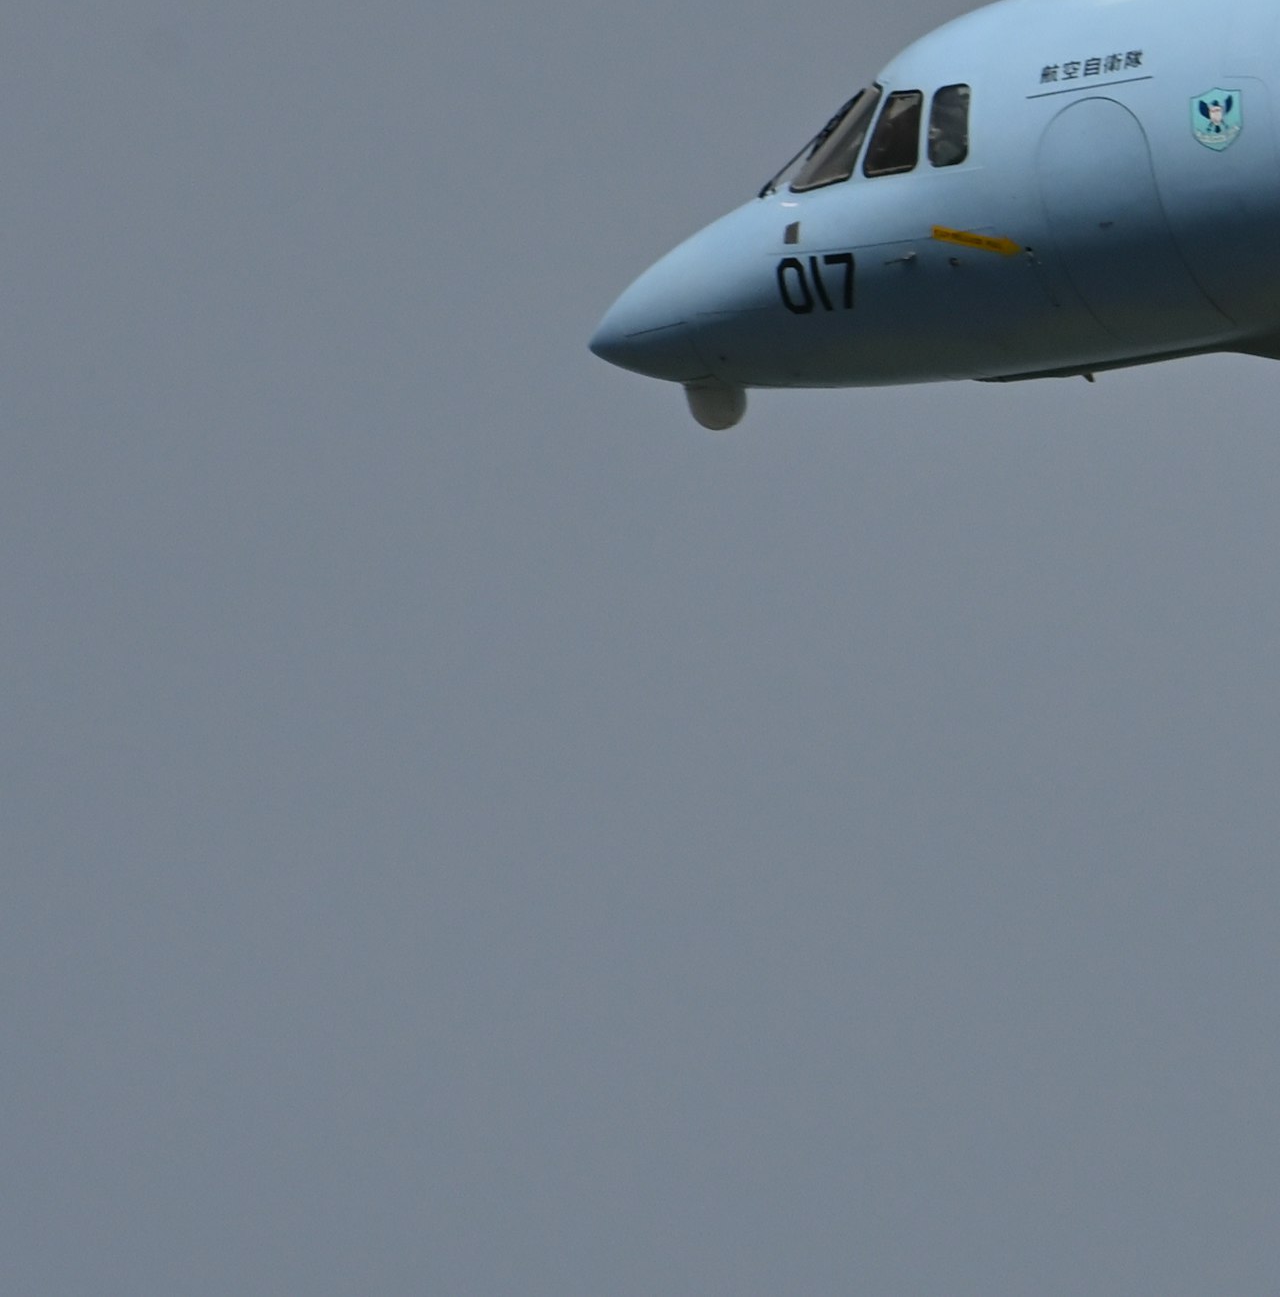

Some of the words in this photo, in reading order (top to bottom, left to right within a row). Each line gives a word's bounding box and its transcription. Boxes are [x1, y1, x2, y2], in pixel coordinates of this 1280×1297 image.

[1040, 49, 1143, 84] 航空自衛隊
[777, 252, 855, 315] 017
